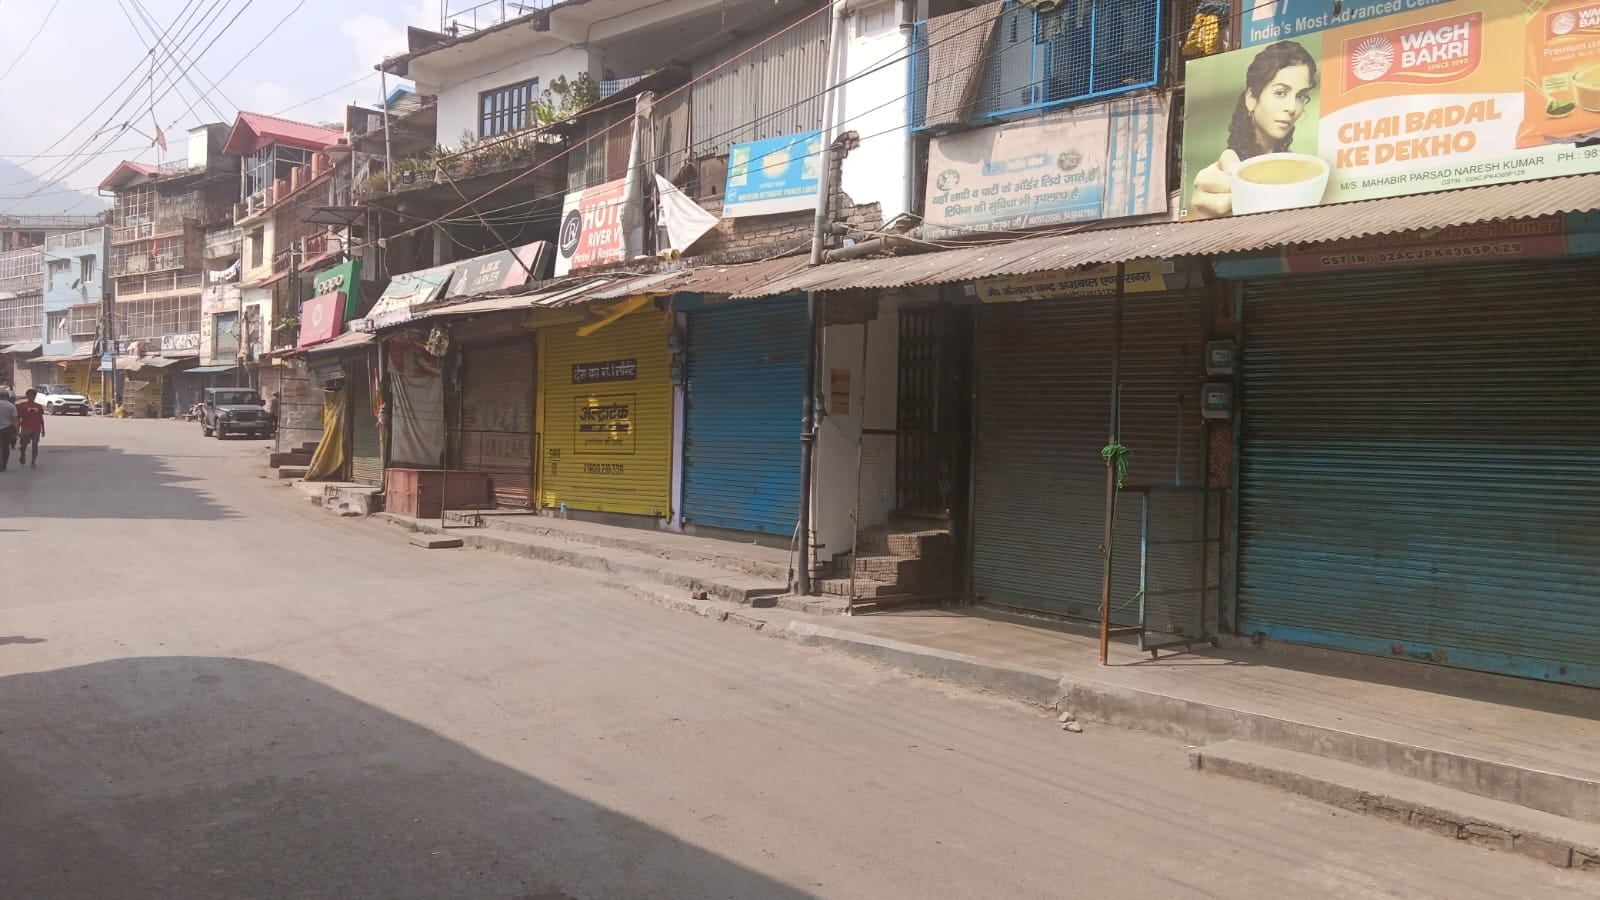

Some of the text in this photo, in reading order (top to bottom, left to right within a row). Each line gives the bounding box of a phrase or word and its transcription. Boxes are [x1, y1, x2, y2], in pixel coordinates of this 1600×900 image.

[1250, 21, 1292, 42] India's
[1296, 12, 1328, 32] Most
[1331, 1, 1401, 25] Advanced
[1579, 8, 1600, 20] WA
[1400, 21, 1470, 51] WAGH
[1401, 39, 1469, 68] BAKRI
[1543, 43, 1587, 57] Premium
[1427, 61, 1449, 71] SINCE
[1337, 98, 1502, 144] CHAI BADAL
[1336, 130, 1477, 169] KE DEKHO
[1362, 174, 1407, 189] MAHABIR
[1409, 168, 1451, 184] PARSAD
[1454, 162, 1500, 178] NARESH
[1503, 155, 1545, 171] KUMAR
[950, 188, 970, 202] शादी
[971, 190, 979, 198] व
[981, 183, 999, 197] पार्टी
[1001, 181, 1011, 193] के
[1014, 175, 1039, 192] ऑर्डर
[1064, 169, 1085, 184] जाते
[973, 200, 986, 213] की
[989, 196, 1017, 215] सुविधा
[1502, 217, 1560, 236] Kumar
[587, 228, 612, 248] RIVER
[574, 251, 590, 264] Hotel
[1321, 255, 1346, 266] GST
[1058, 278, 1099, 291] अग्रवाल
[574, 365, 587, 382] देश
[588, 368, 599, 379] का
